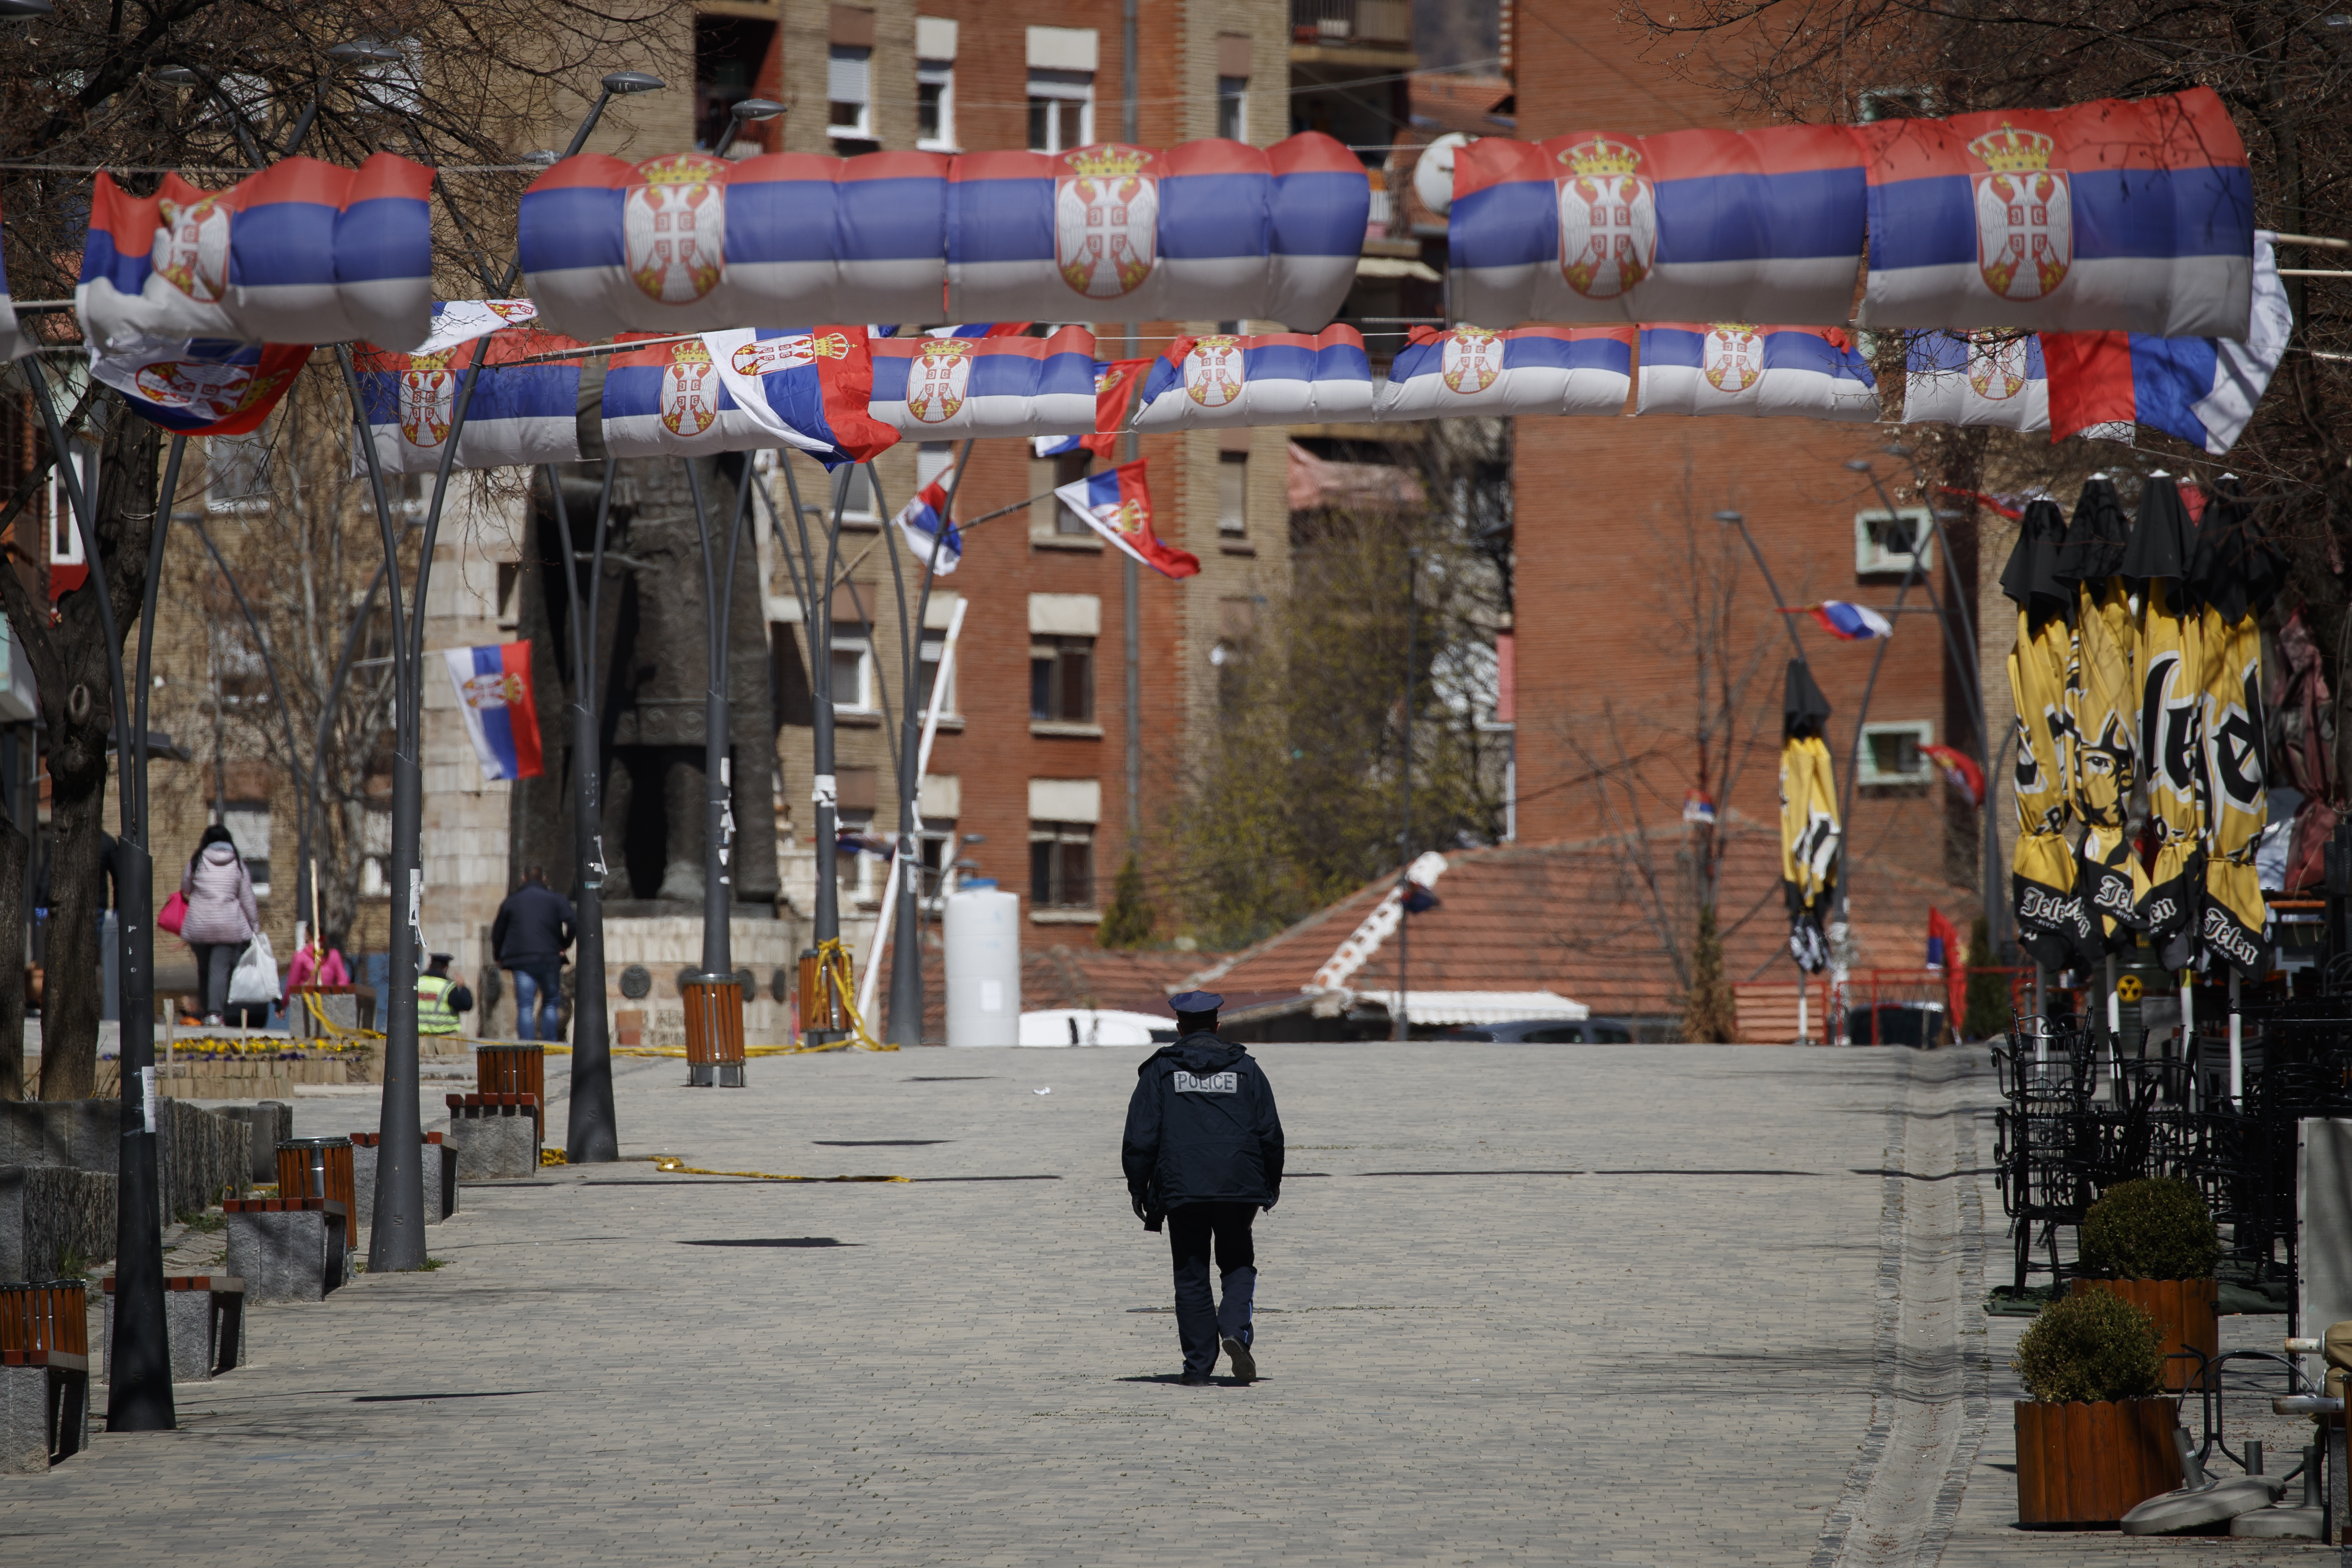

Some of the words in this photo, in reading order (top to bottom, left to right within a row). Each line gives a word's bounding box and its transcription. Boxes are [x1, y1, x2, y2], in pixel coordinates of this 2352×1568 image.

[2094, 875, 2134, 913] Jel
[2149, 898, 2177, 927] en
[2203, 907, 2259, 965] Jelen
[1178, 1073, 1233, 1091] POLICE
